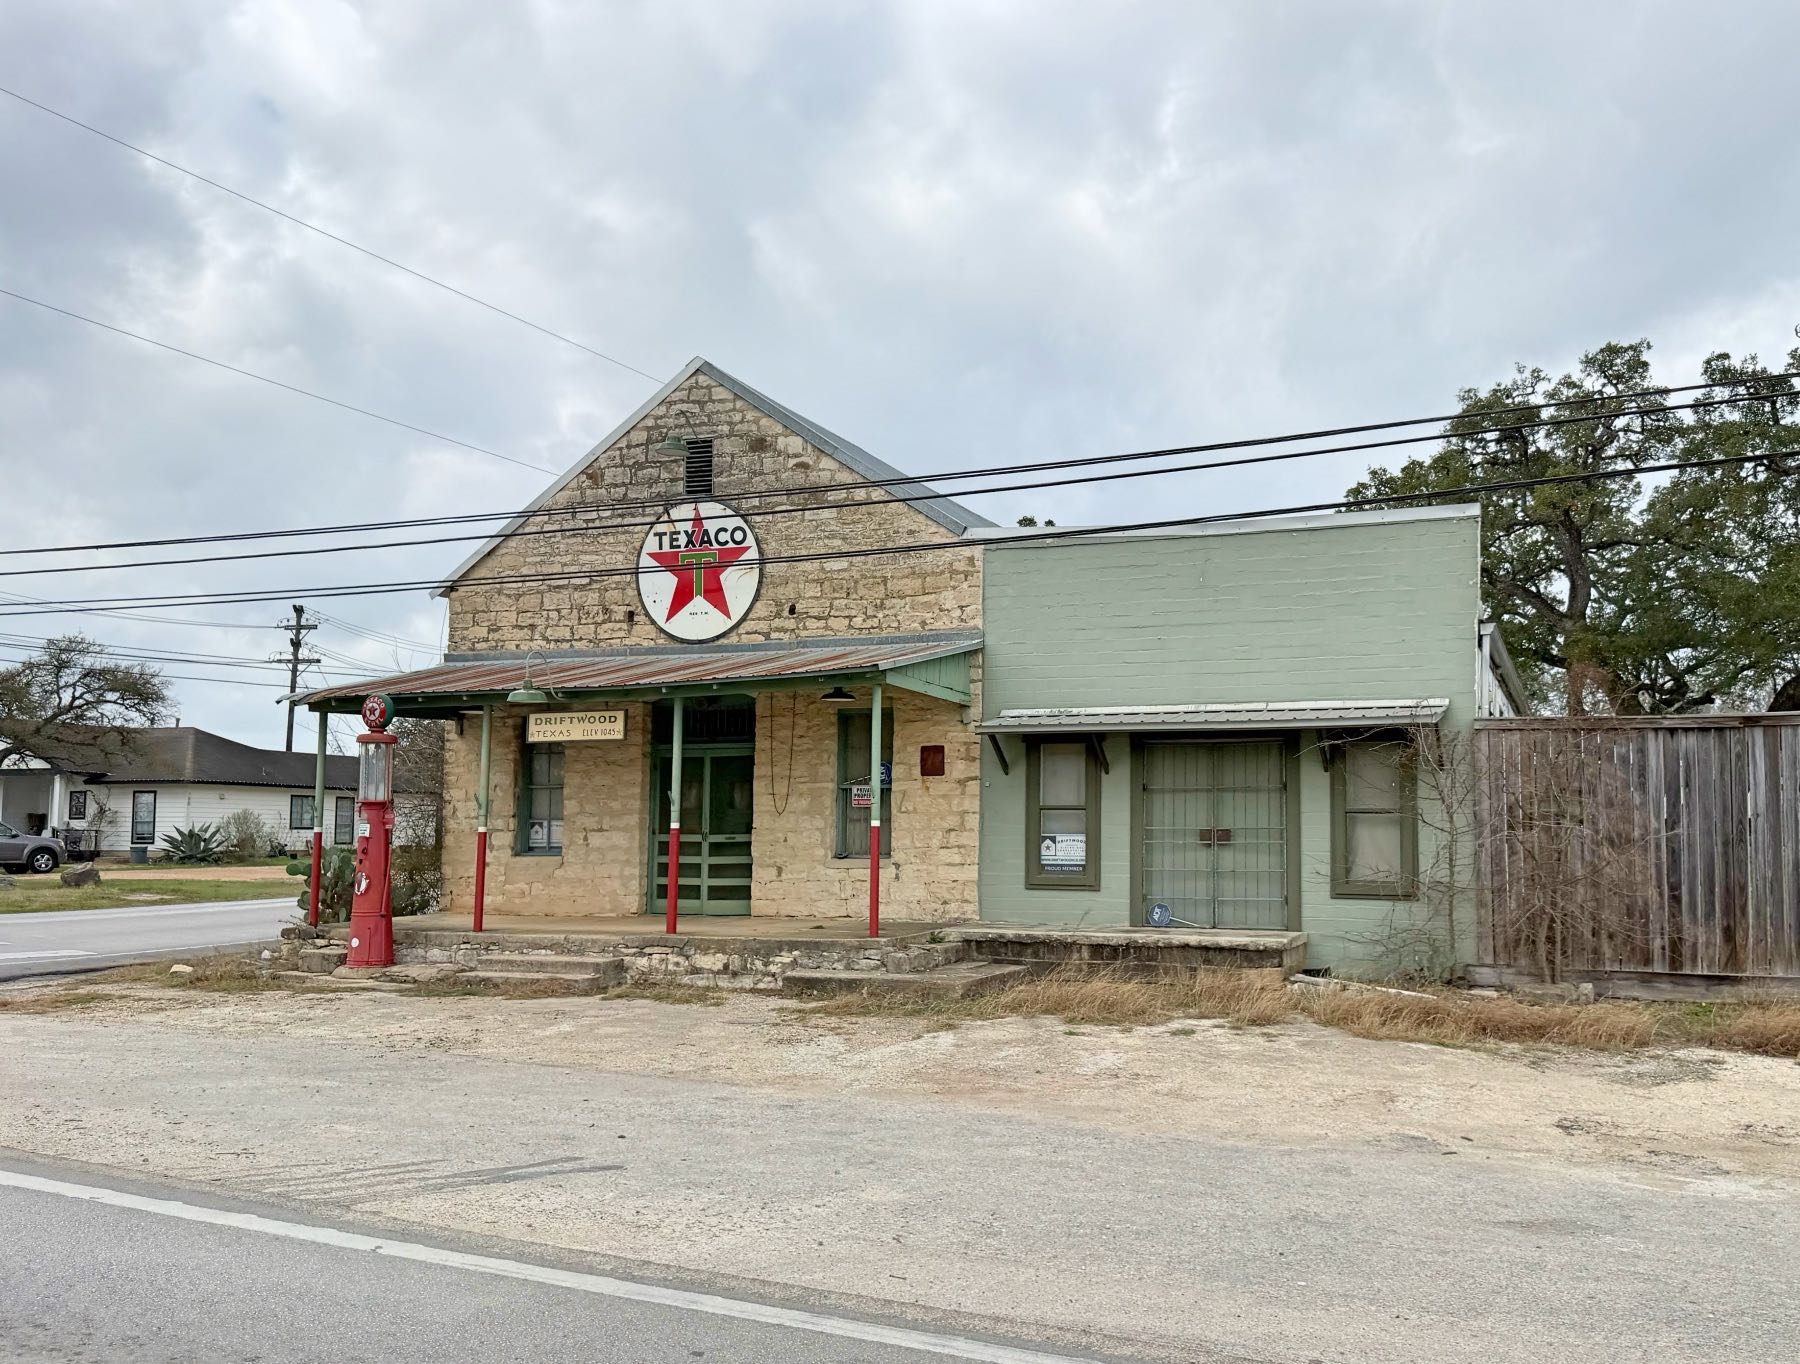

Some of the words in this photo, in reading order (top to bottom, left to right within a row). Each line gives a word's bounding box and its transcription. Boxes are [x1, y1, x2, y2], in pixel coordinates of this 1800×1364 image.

[653, 525, 747, 551] TEXACO
[534, 714, 618, 726] DRIFTWOOD
[536, 729, 572, 738] TEXAS
[600, 728, 616, 736] 1045
